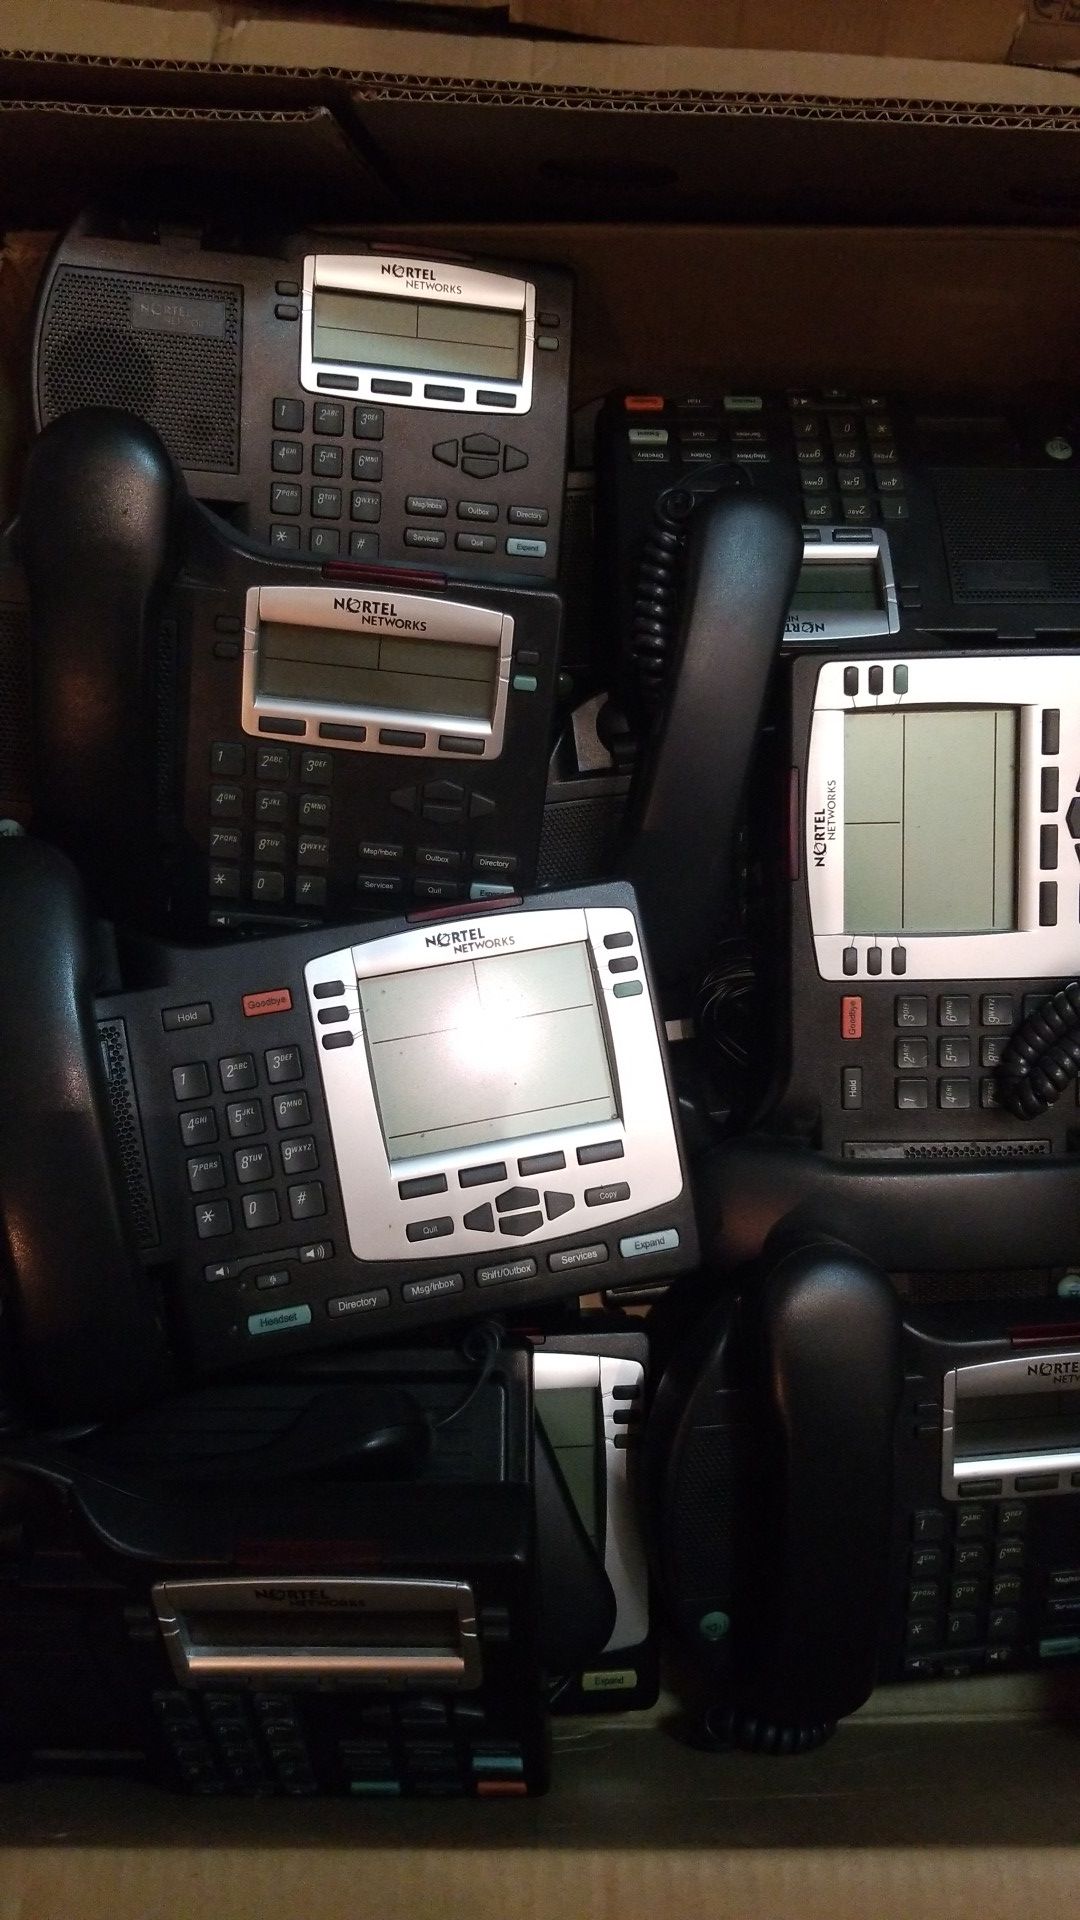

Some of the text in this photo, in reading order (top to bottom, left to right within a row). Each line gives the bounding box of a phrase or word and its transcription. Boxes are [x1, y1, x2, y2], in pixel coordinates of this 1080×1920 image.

[382, 264, 436, 281] NORTEL
[406, 280, 462, 294] NETWORKS
[281, 405, 286, 416] 1
[638, 452, 664, 460] Directory
[468, 507, 489, 515] Outbox
[516, 511, 542, 520] Directory
[316, 535, 323, 546] 0
[413, 534, 440, 543] Services
[471, 539, 484, 547] Quit
[334, 598, 397, 617] NORTEL
[362, 616, 427, 632] NETWORKS
[218, 751, 224, 762] 1
[828, 779, 836, 841] NETWORKS
[813, 808, 826, 867] NORTEL
[363, 847, 398, 858] Msg/Inbox
[426, 854, 449, 864] Outbox
[480, 859, 510, 869] Directory
[257, 878, 265, 889] 0
[364, 881, 394, 890] Services
[428, 886, 442, 895] Quit
[425, 928, 485, 948] NORTEL
[454, 936, 515, 954] NETWORKS
[248, 996, 286, 1010] Goodbye
[177, 1012, 198, 1023] Hold
[848, 1000, 858, 1035] Goodbye
[180, 1073, 186, 1085] 1
[849, 1080, 857, 1097] Hold
[297, 1191, 307, 1206] #
[600, 1191, 618, 1201] Copy
[250, 1201, 257, 1215] 0
[422, 1226, 438, 1235] Quit
[634, 1236, 665, 1251] Expand
[561, 1250, 598, 1265] Services
[482, 1264, 532, 1281] Shift/Outbox
[411, 1279, 455, 1296] Msg/Inbox
[338, 1296, 377, 1312] Directory
[260, 1312, 298, 1328] Headset
[1028, 1362, 1079, 1376] NORTE
[920, 1520, 925, 1531] 1
[254, 1590, 329, 1601] NORTEL
[594, 1676, 624, 1687] Expand
